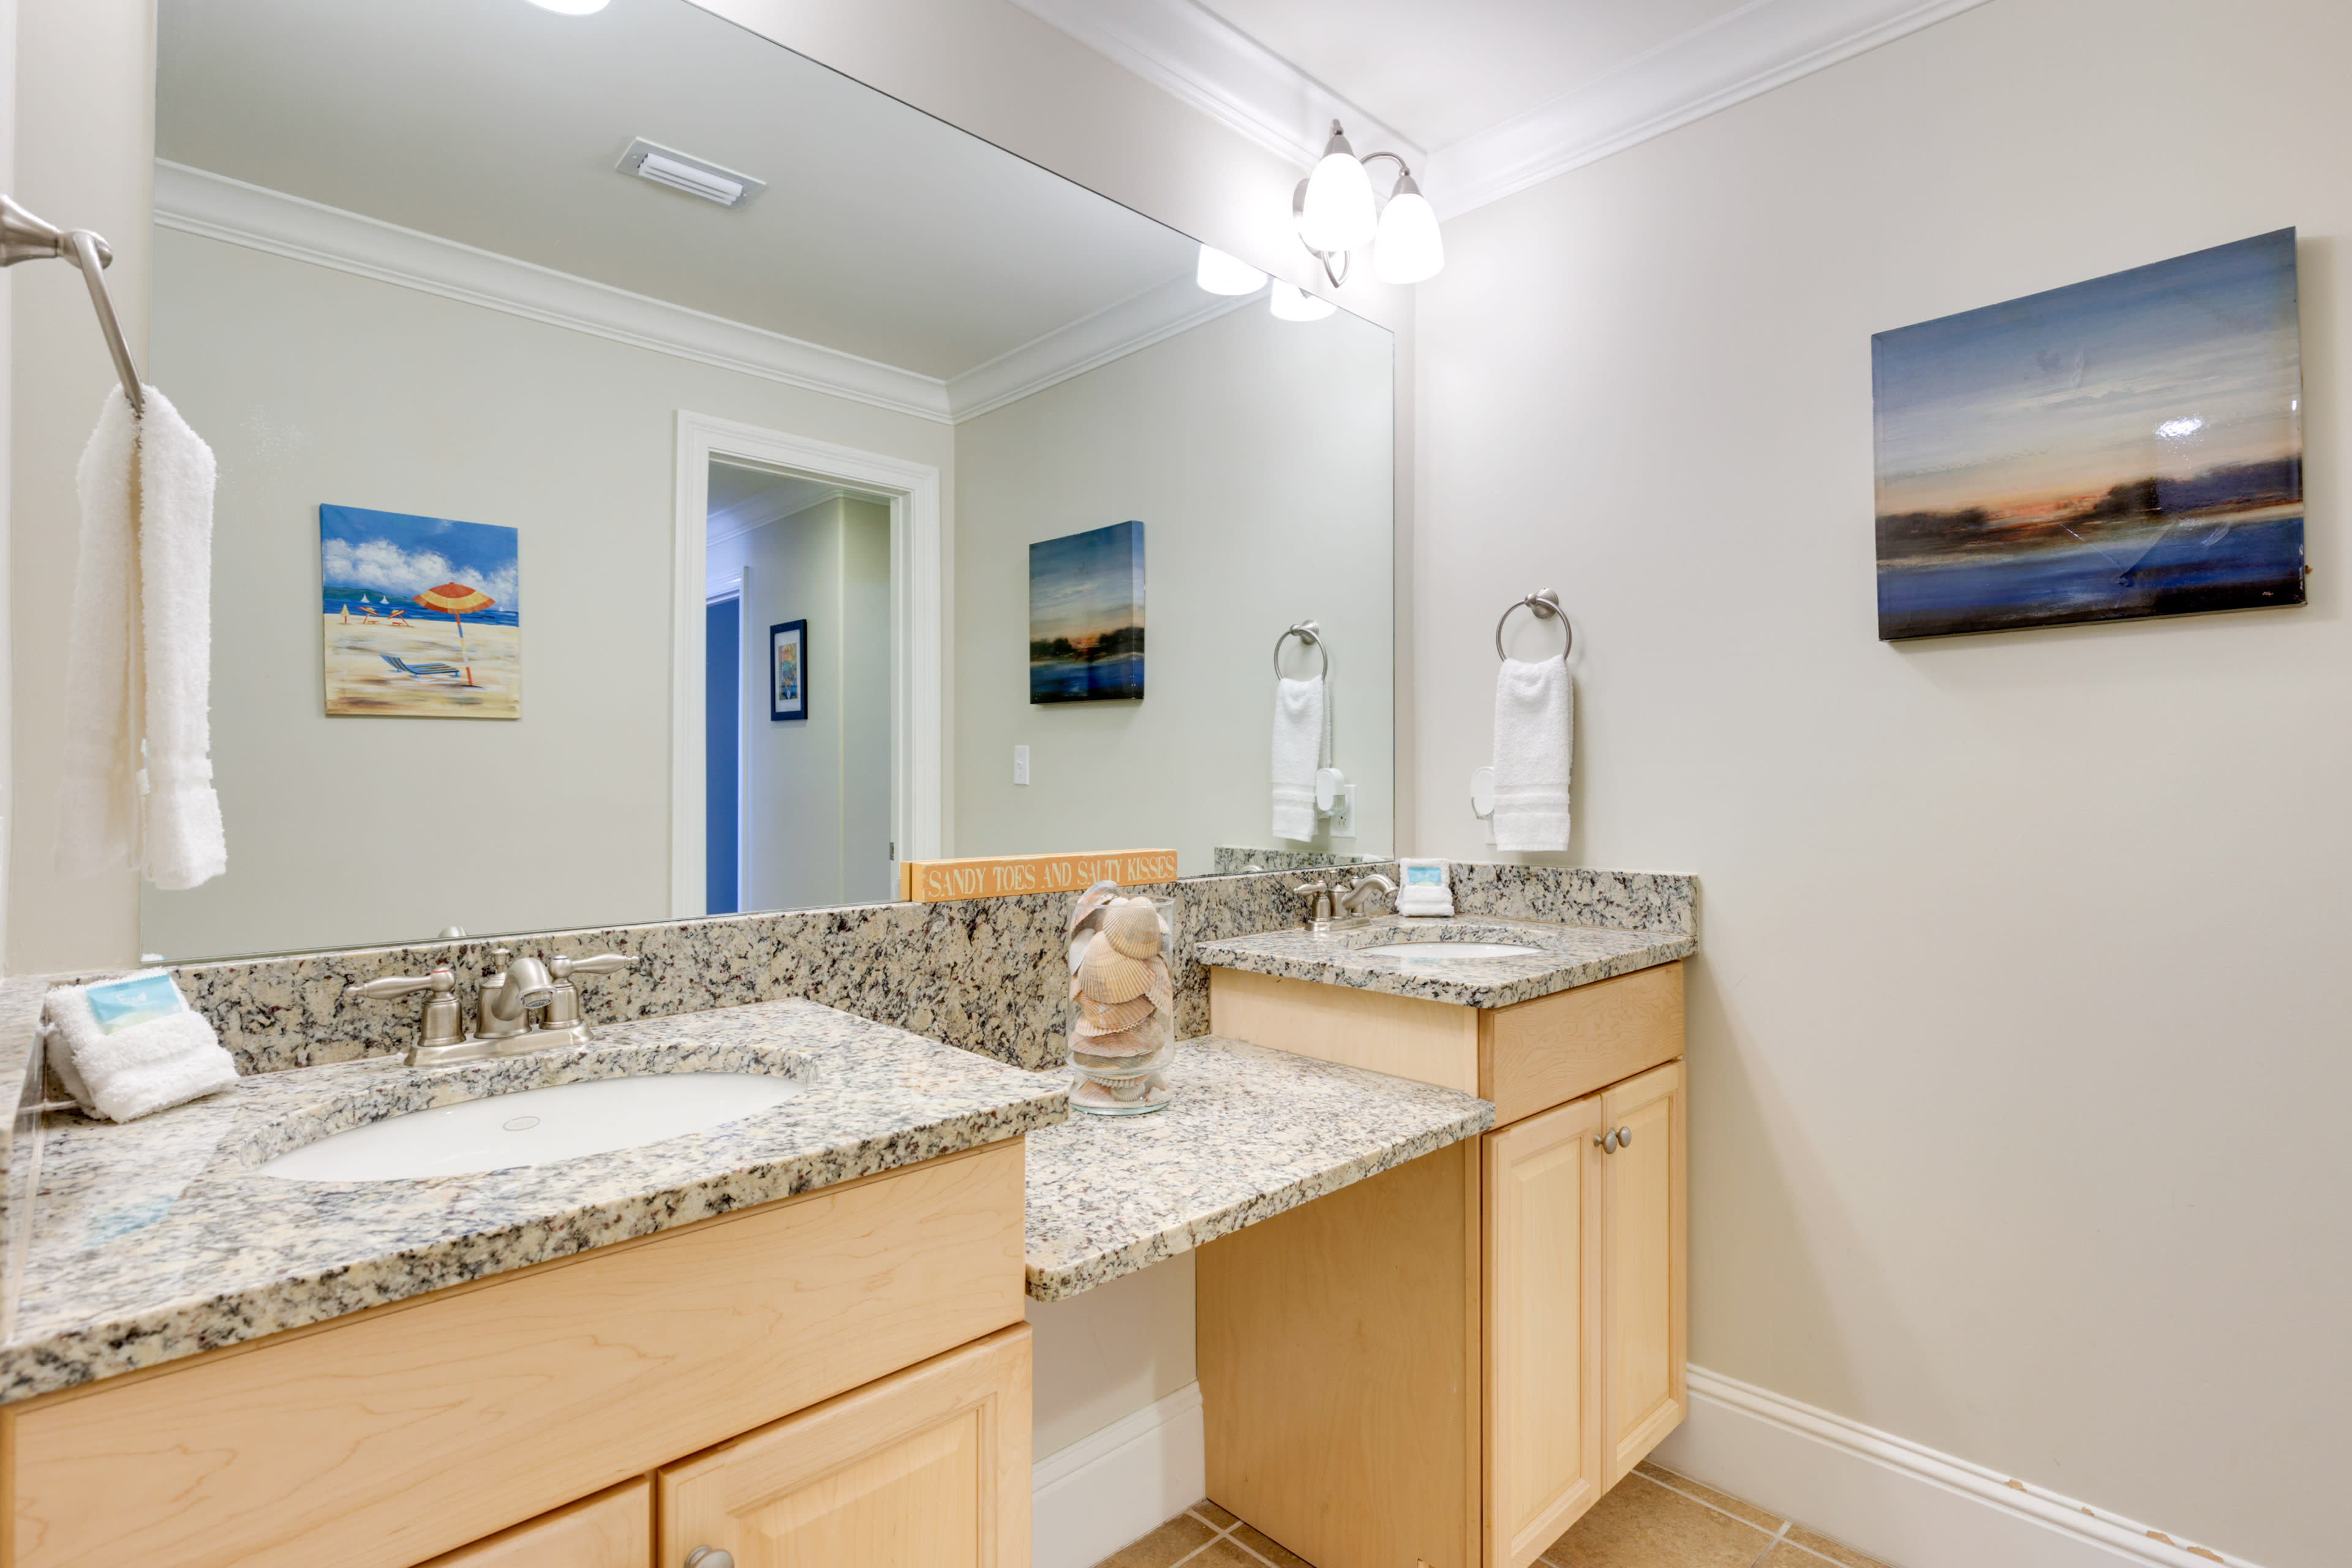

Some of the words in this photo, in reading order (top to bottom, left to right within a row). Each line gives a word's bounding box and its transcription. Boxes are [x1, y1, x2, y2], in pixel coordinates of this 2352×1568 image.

[929, 867, 986, 897] SANDY
[993, 864, 1035, 892] TOES
[1041, 862, 1071, 889] AND
[1077, 858, 1122, 885] SALTY
[1128, 856, 1175, 881] KISSES
